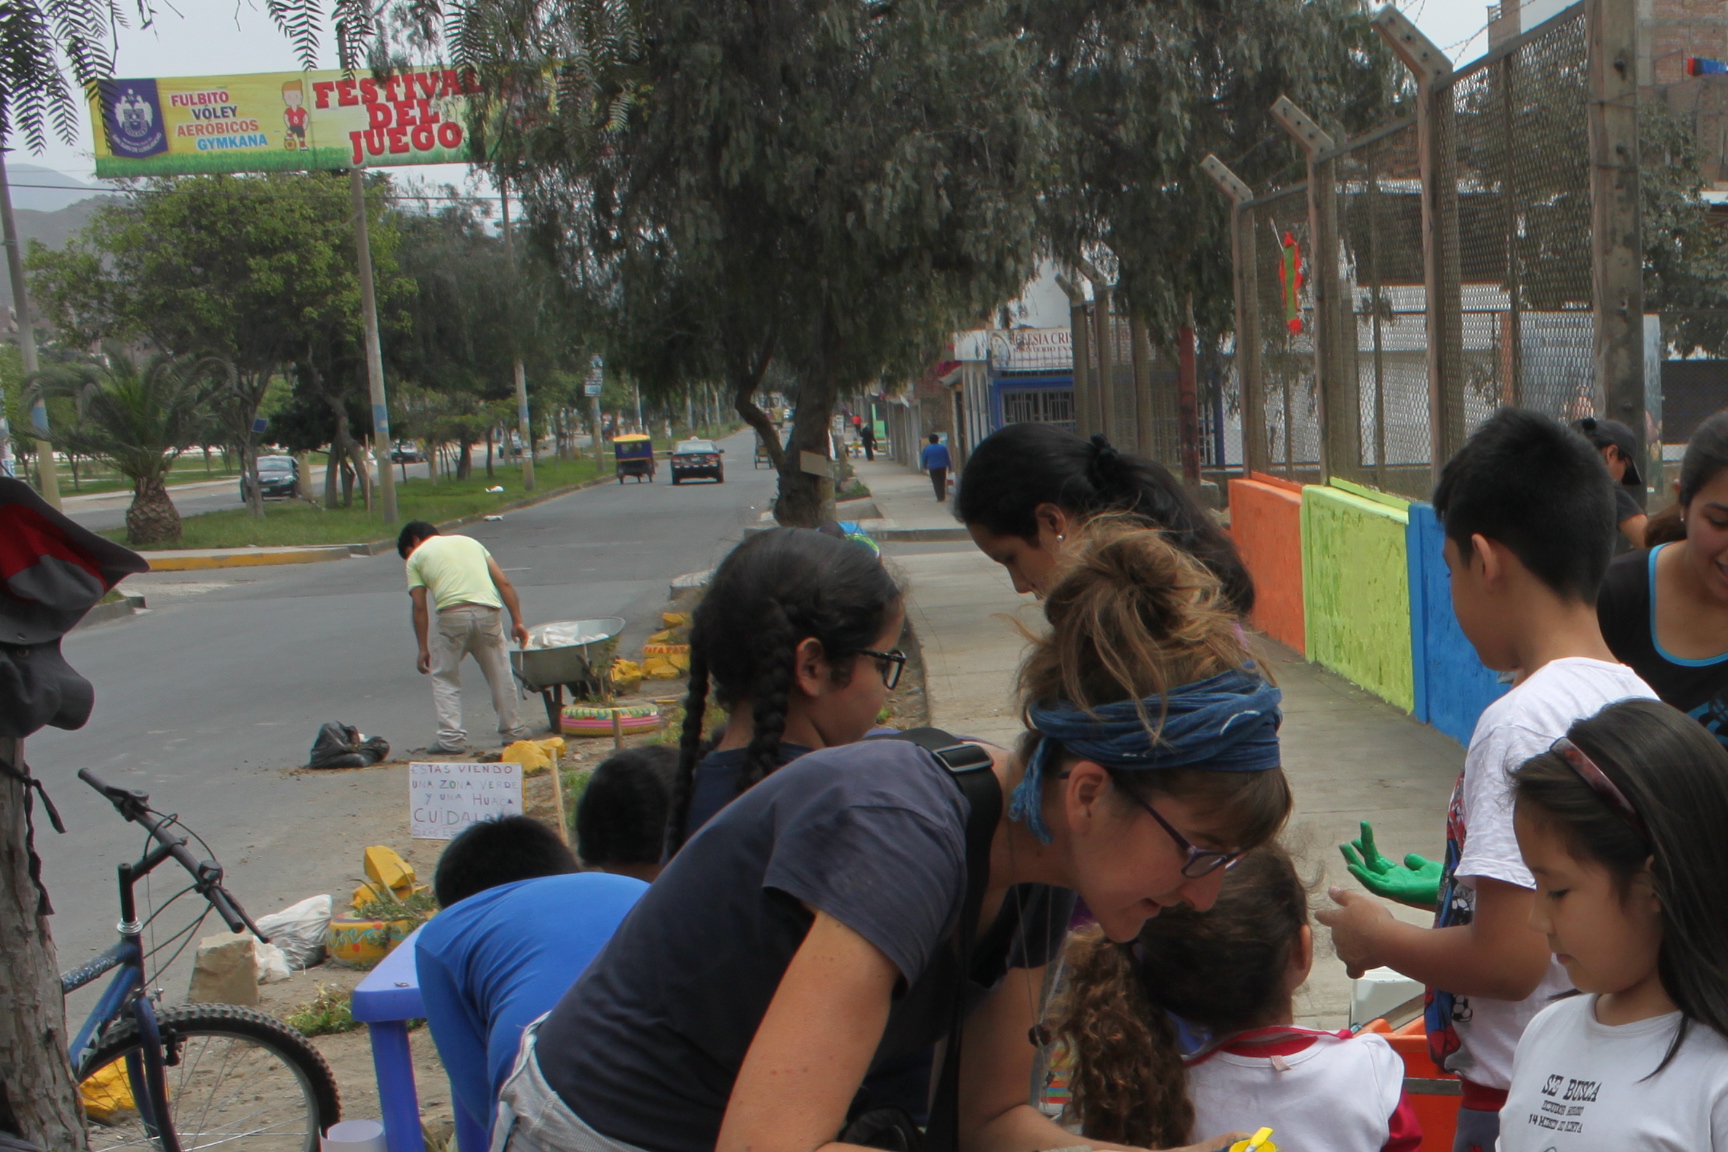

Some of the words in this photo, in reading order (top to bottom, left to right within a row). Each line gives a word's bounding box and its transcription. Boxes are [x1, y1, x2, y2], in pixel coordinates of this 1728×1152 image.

[170, 91, 229, 107] FULBITO
[192, 105, 238, 121] VÓLEY
[366, 99, 440, 129] DEL
[177, 119, 259, 137] AERÓBICOS
[196, 133, 268, 151] GYMKANA
[349, 121, 463, 164] JUEGO
[1011, 332, 1049, 345] IGLESIA
[411, 764, 451, 774] ESTAS
[458, 765, 513, 774] VIENDO
[412, 780, 434, 789] UNA
[439, 780, 473, 790] ZONA
[480, 780, 519, 790] VERDE
[440, 793, 463, 801] UNA
[1562, 1078, 1603, 1103] BUSCA
